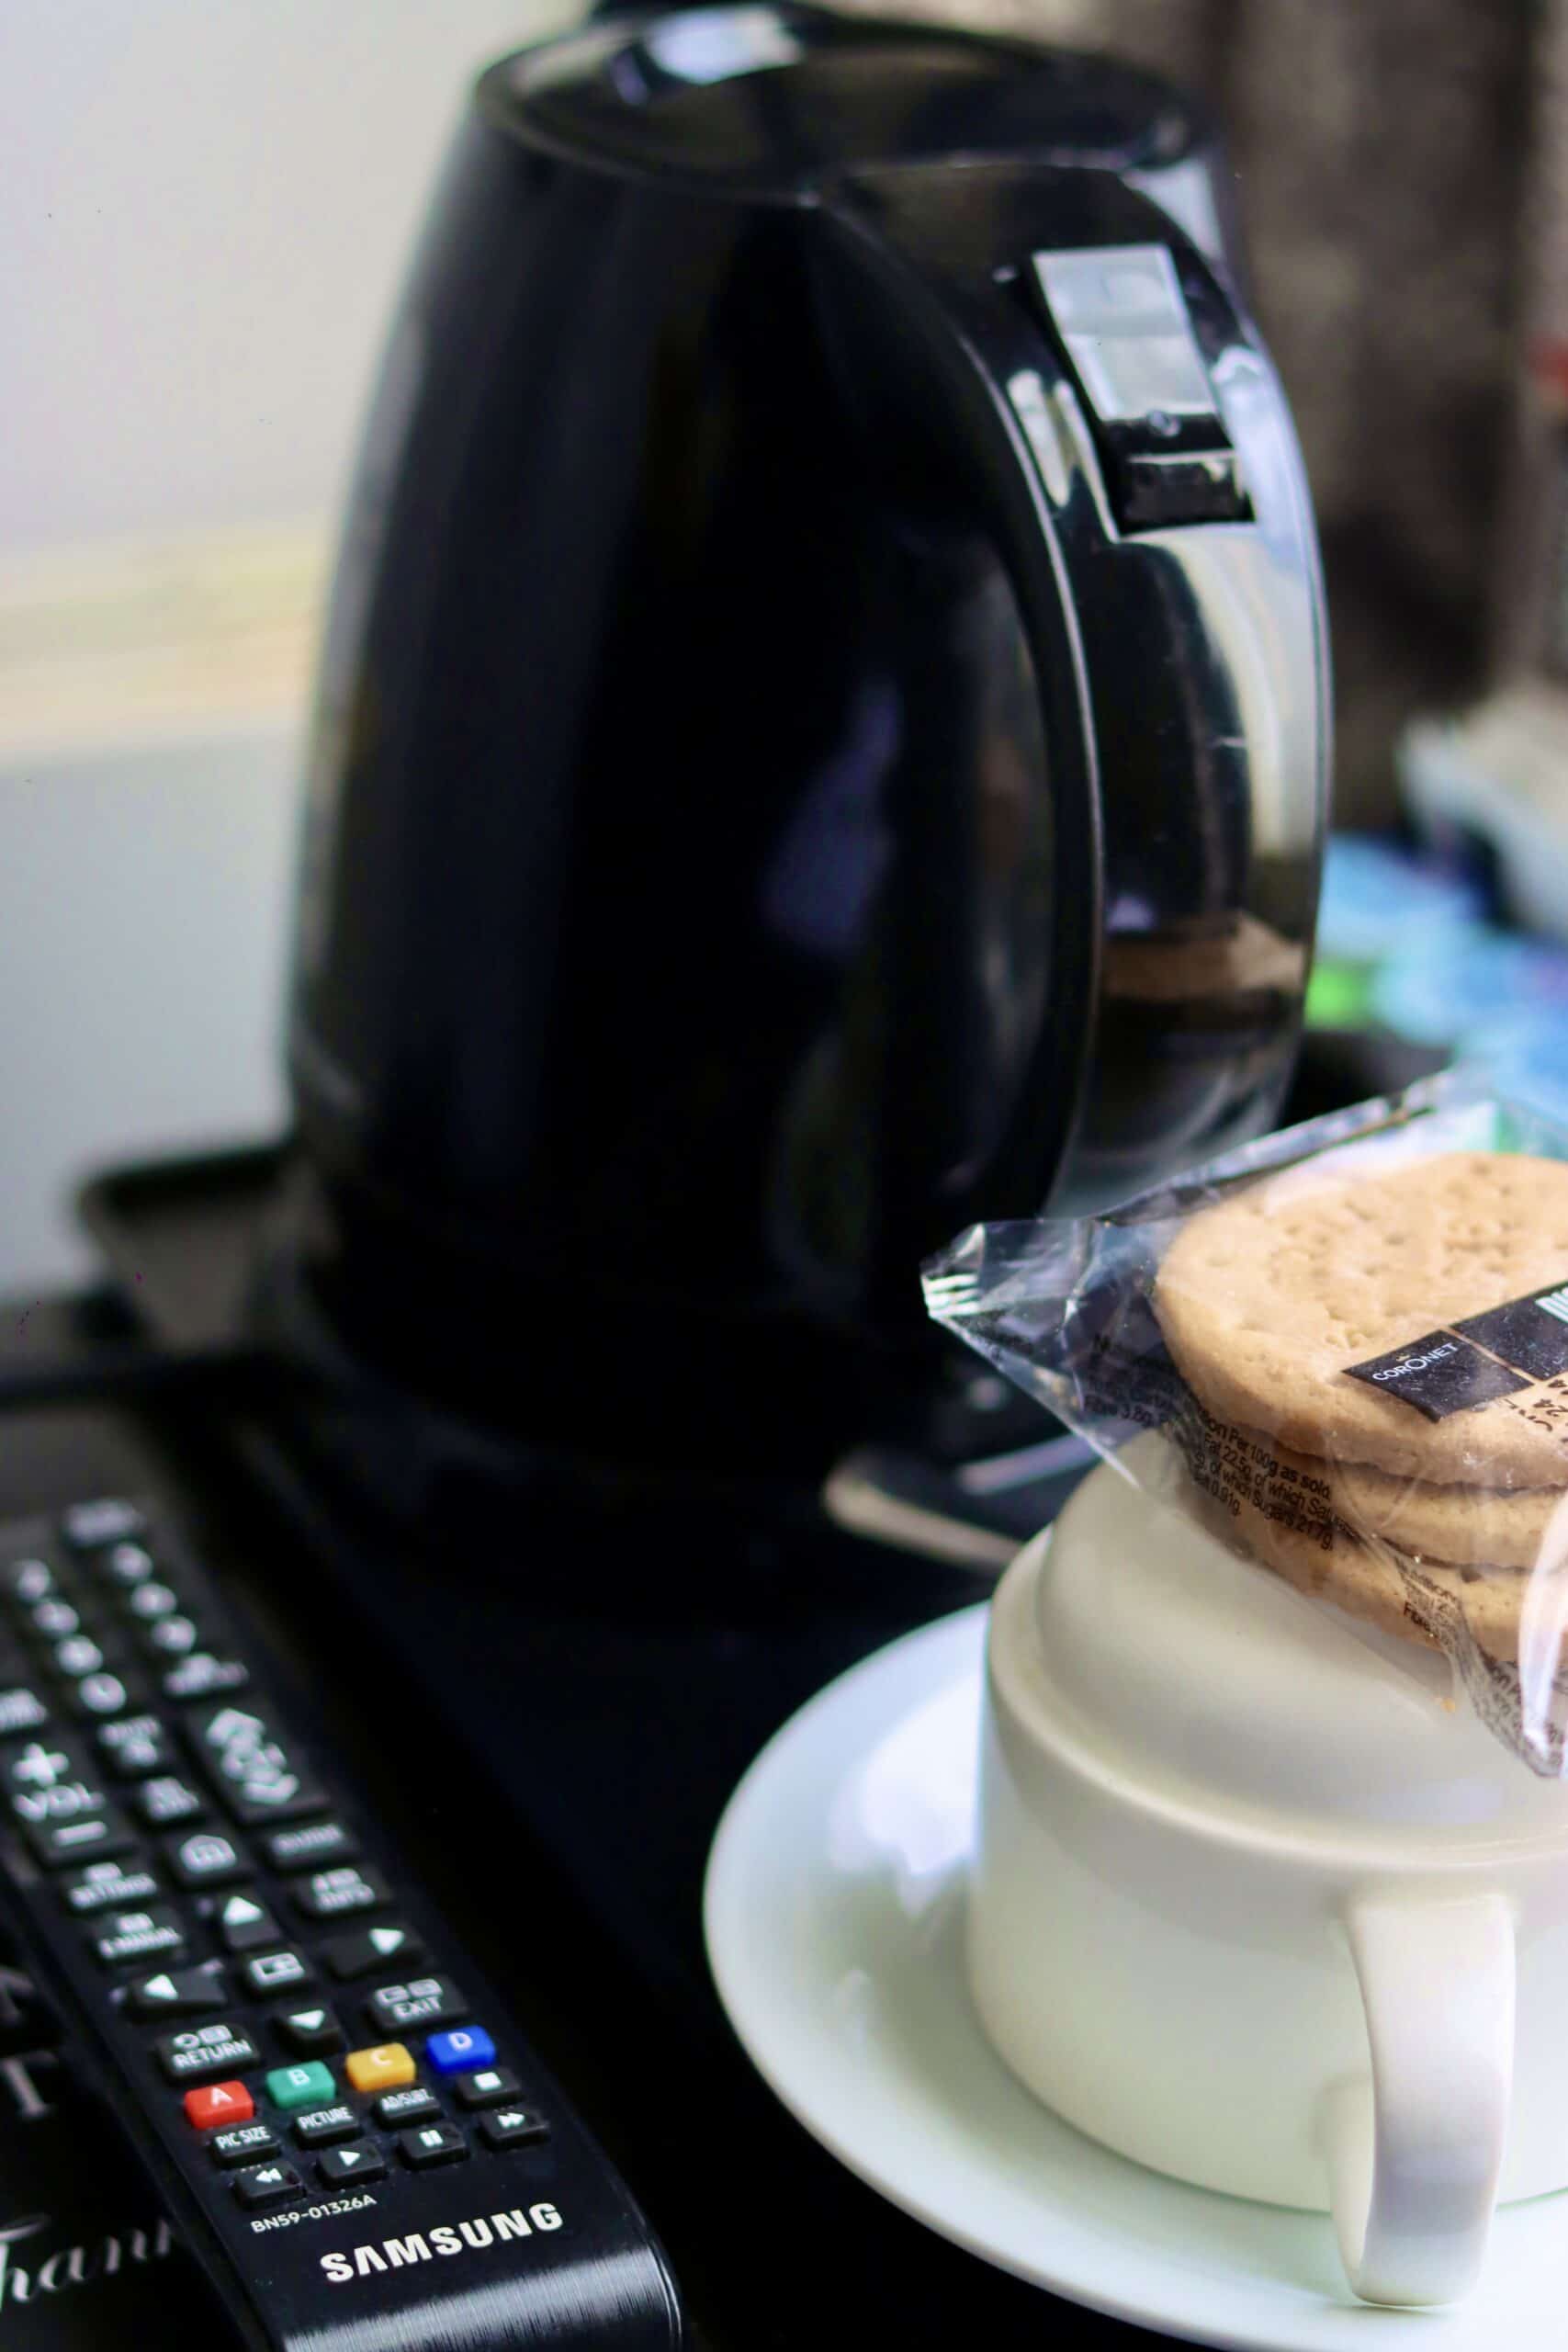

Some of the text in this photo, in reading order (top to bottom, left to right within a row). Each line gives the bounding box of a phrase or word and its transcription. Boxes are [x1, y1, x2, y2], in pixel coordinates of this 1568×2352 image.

[1372, 1342, 1458, 1381] CORONET
[1280, 1465, 1299, 1485] as
[13, 1781, 106, 1823] VOL
[393, 1996, 442, 2022] EXIT
[172, 2039, 253, 2068] RETURN
[210, 2031, 473, 2107] A B C D
[297, 2106, 354, 2131] PICTURE
[215, 2125, 272, 2150] PIC SIZE
[250, 2194, 378, 2233] BN59-01326A
[320, 2202, 564, 2283] SAMSUNG
